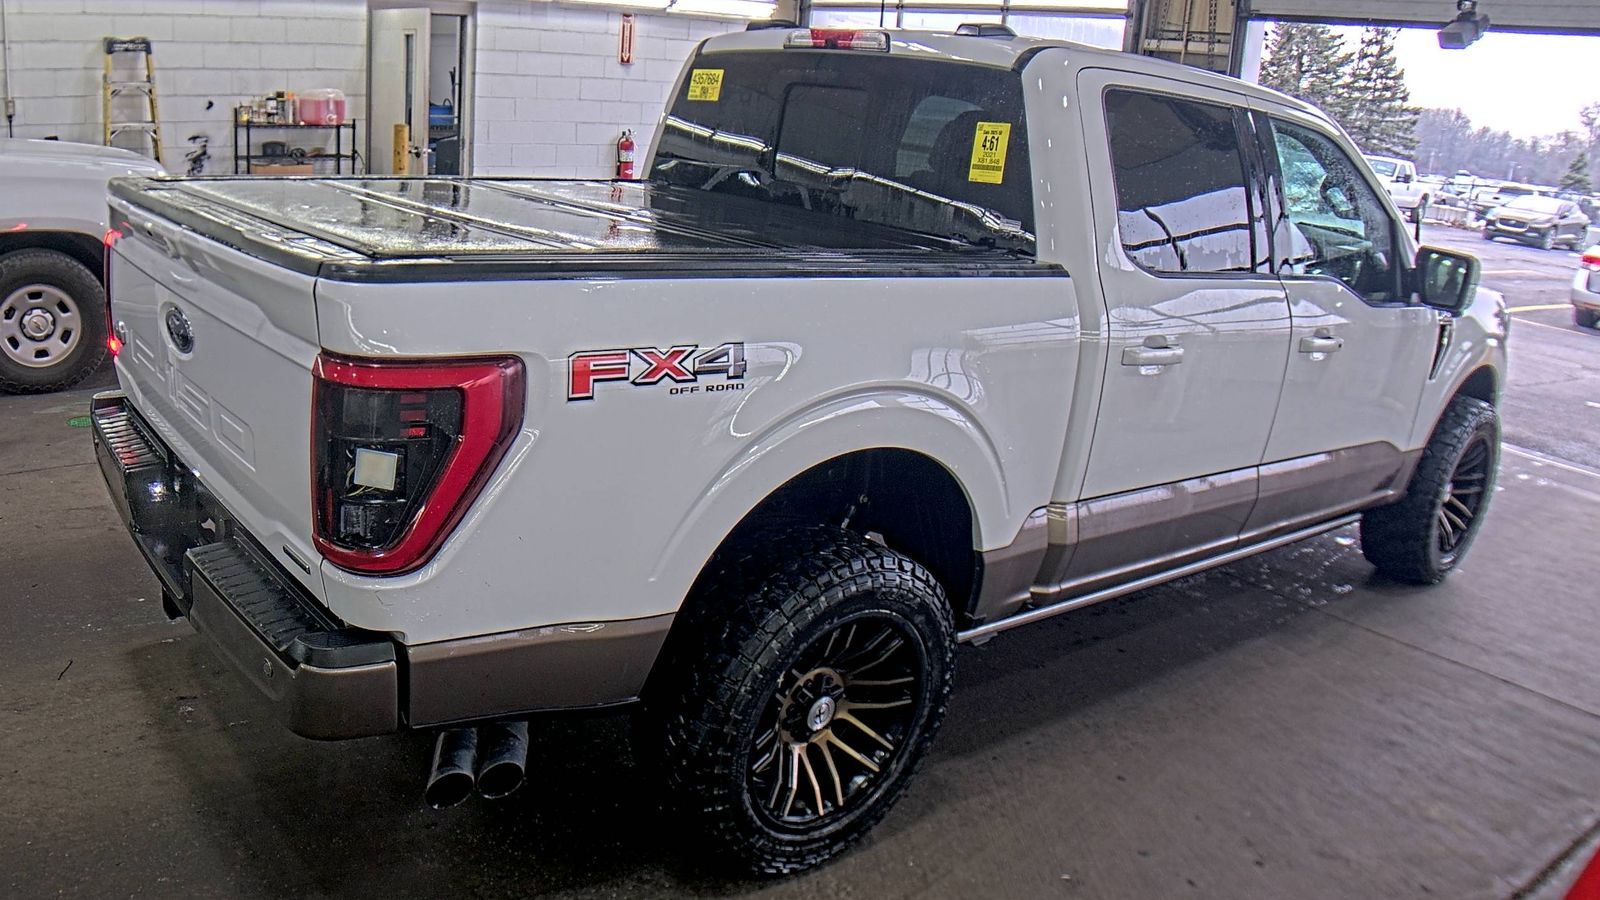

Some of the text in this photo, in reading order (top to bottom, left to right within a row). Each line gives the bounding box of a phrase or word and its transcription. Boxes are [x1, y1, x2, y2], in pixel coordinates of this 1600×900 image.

[982, 135, 999, 151] 4:61
[567, 342, 747, 401] FX4
[669, 382, 745, 395] OFF ROAD
